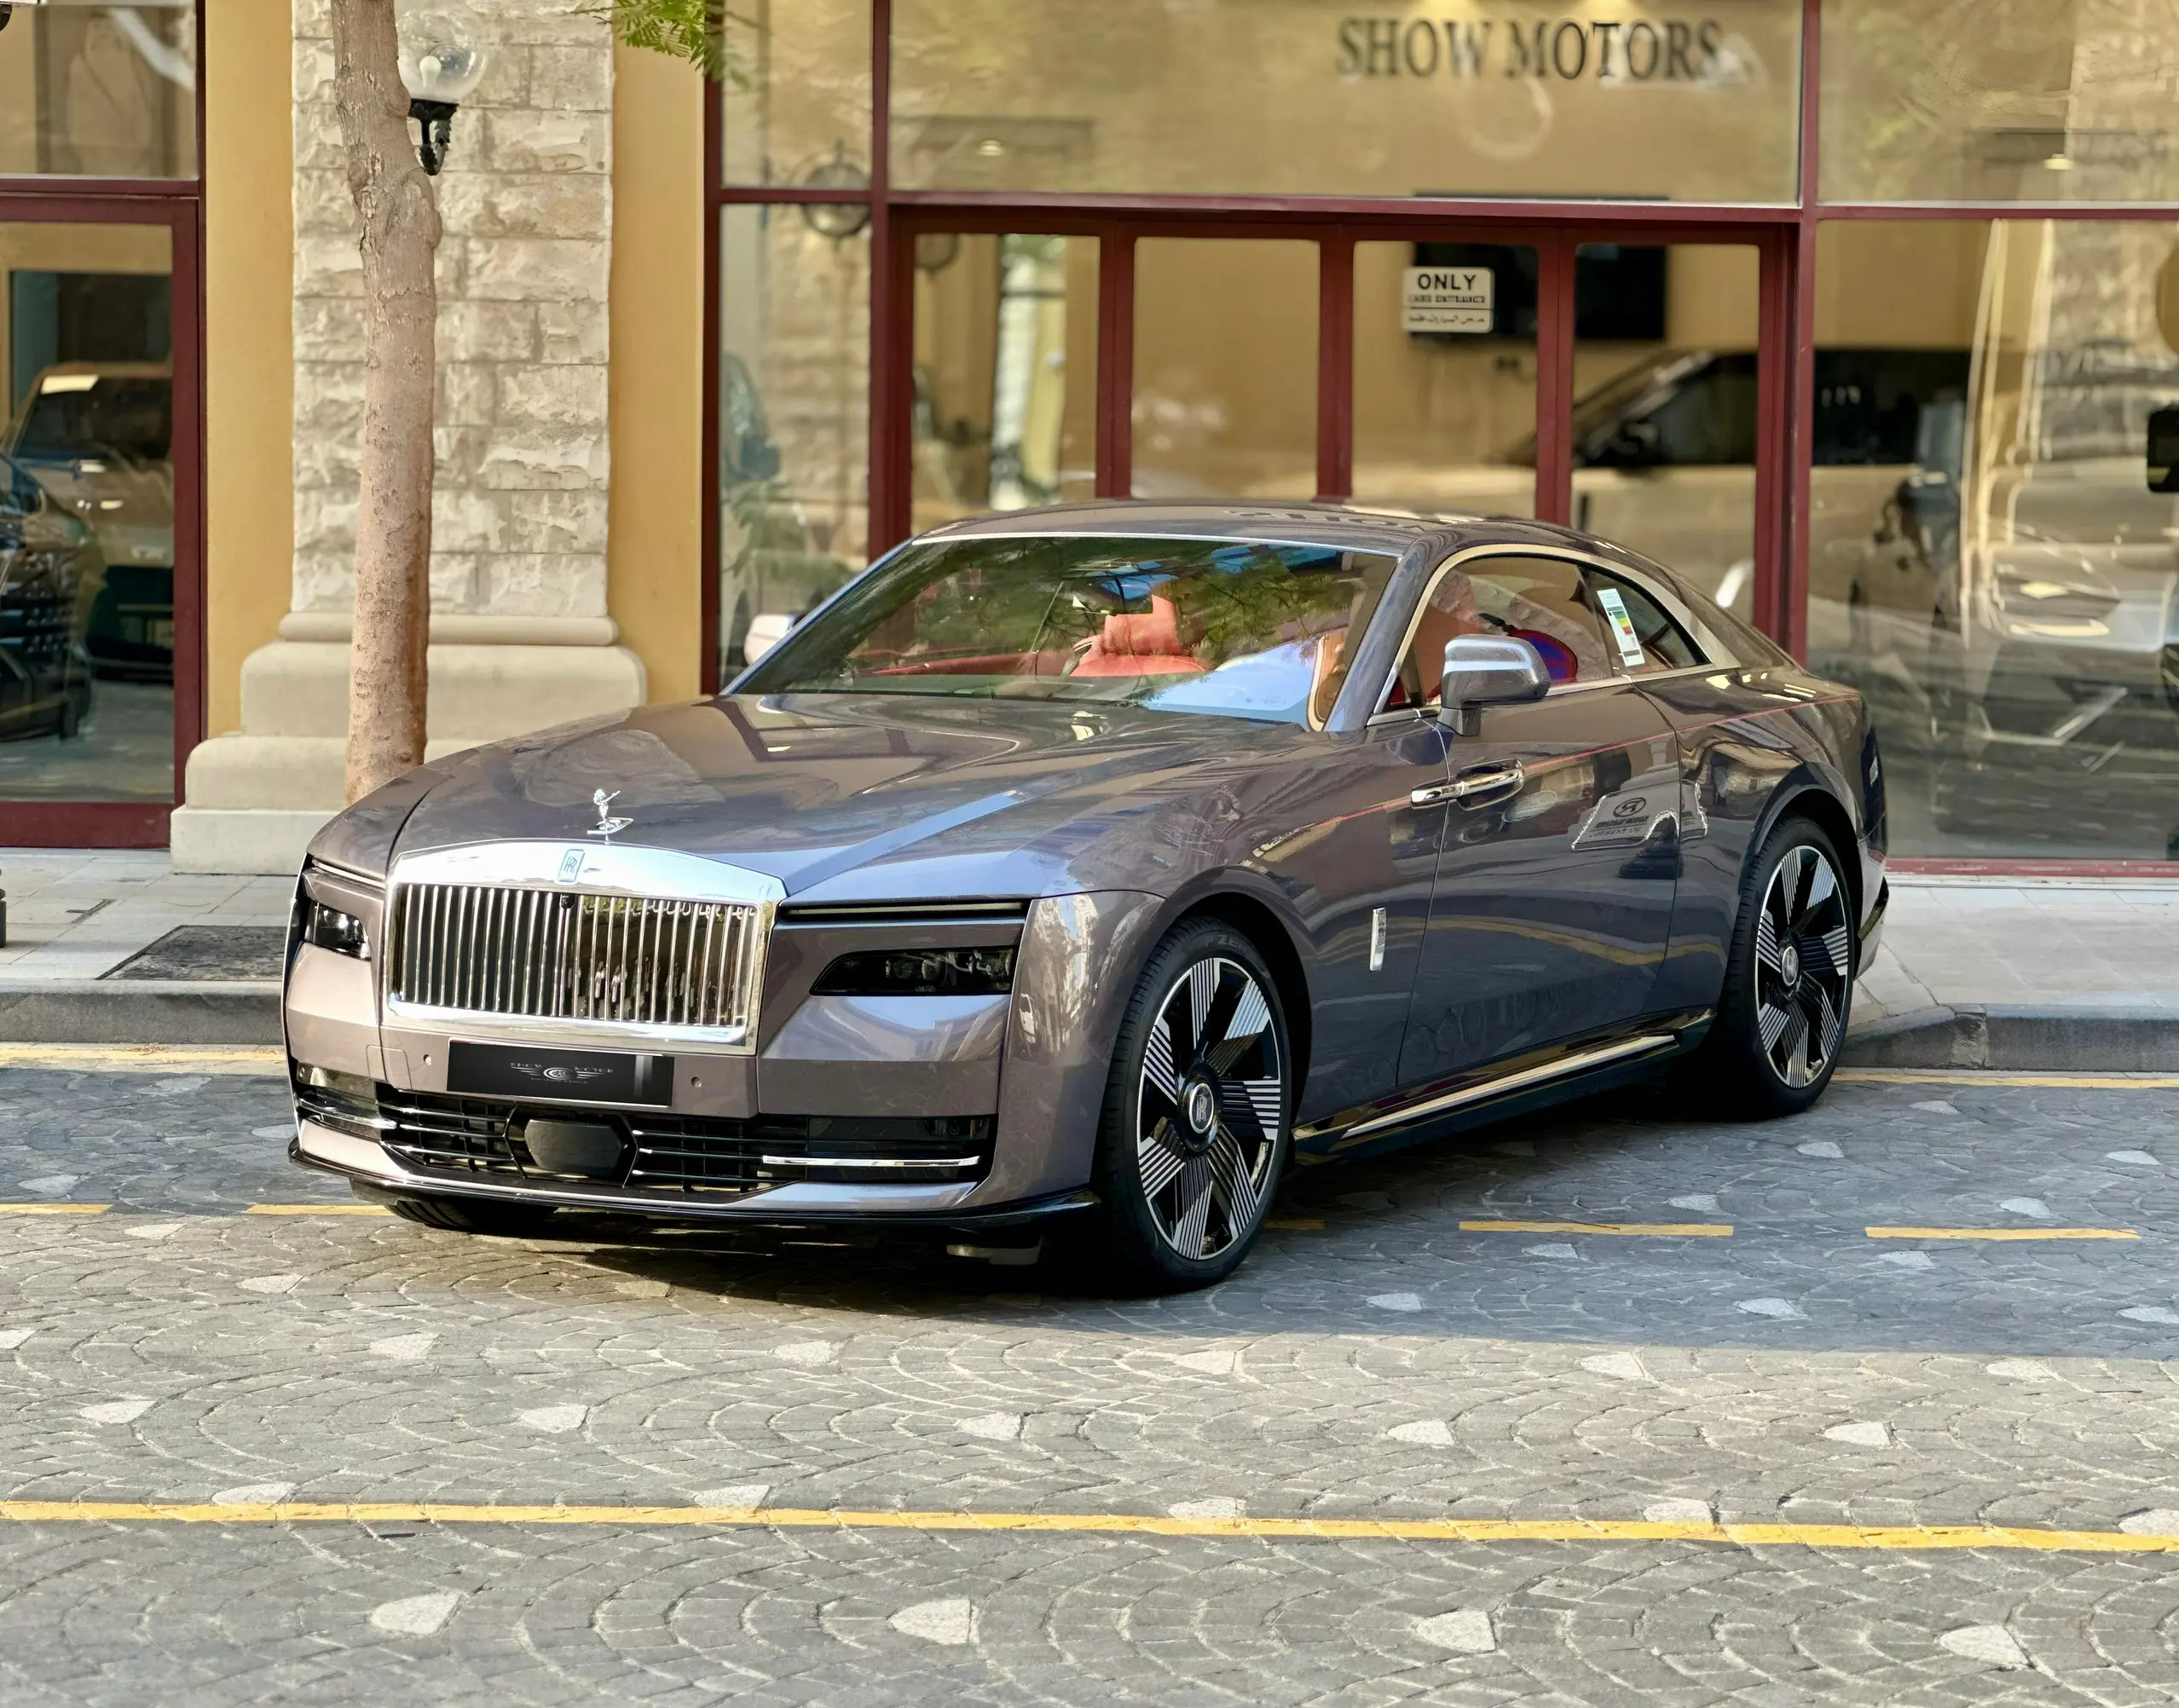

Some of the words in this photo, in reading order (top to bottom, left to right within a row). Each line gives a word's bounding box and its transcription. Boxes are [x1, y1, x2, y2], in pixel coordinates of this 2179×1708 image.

[1335, 19, 1494, 78] SHOW
[1503, 17, 1722, 80] MOTORS
[1417, 273, 1477, 291] ONLY
